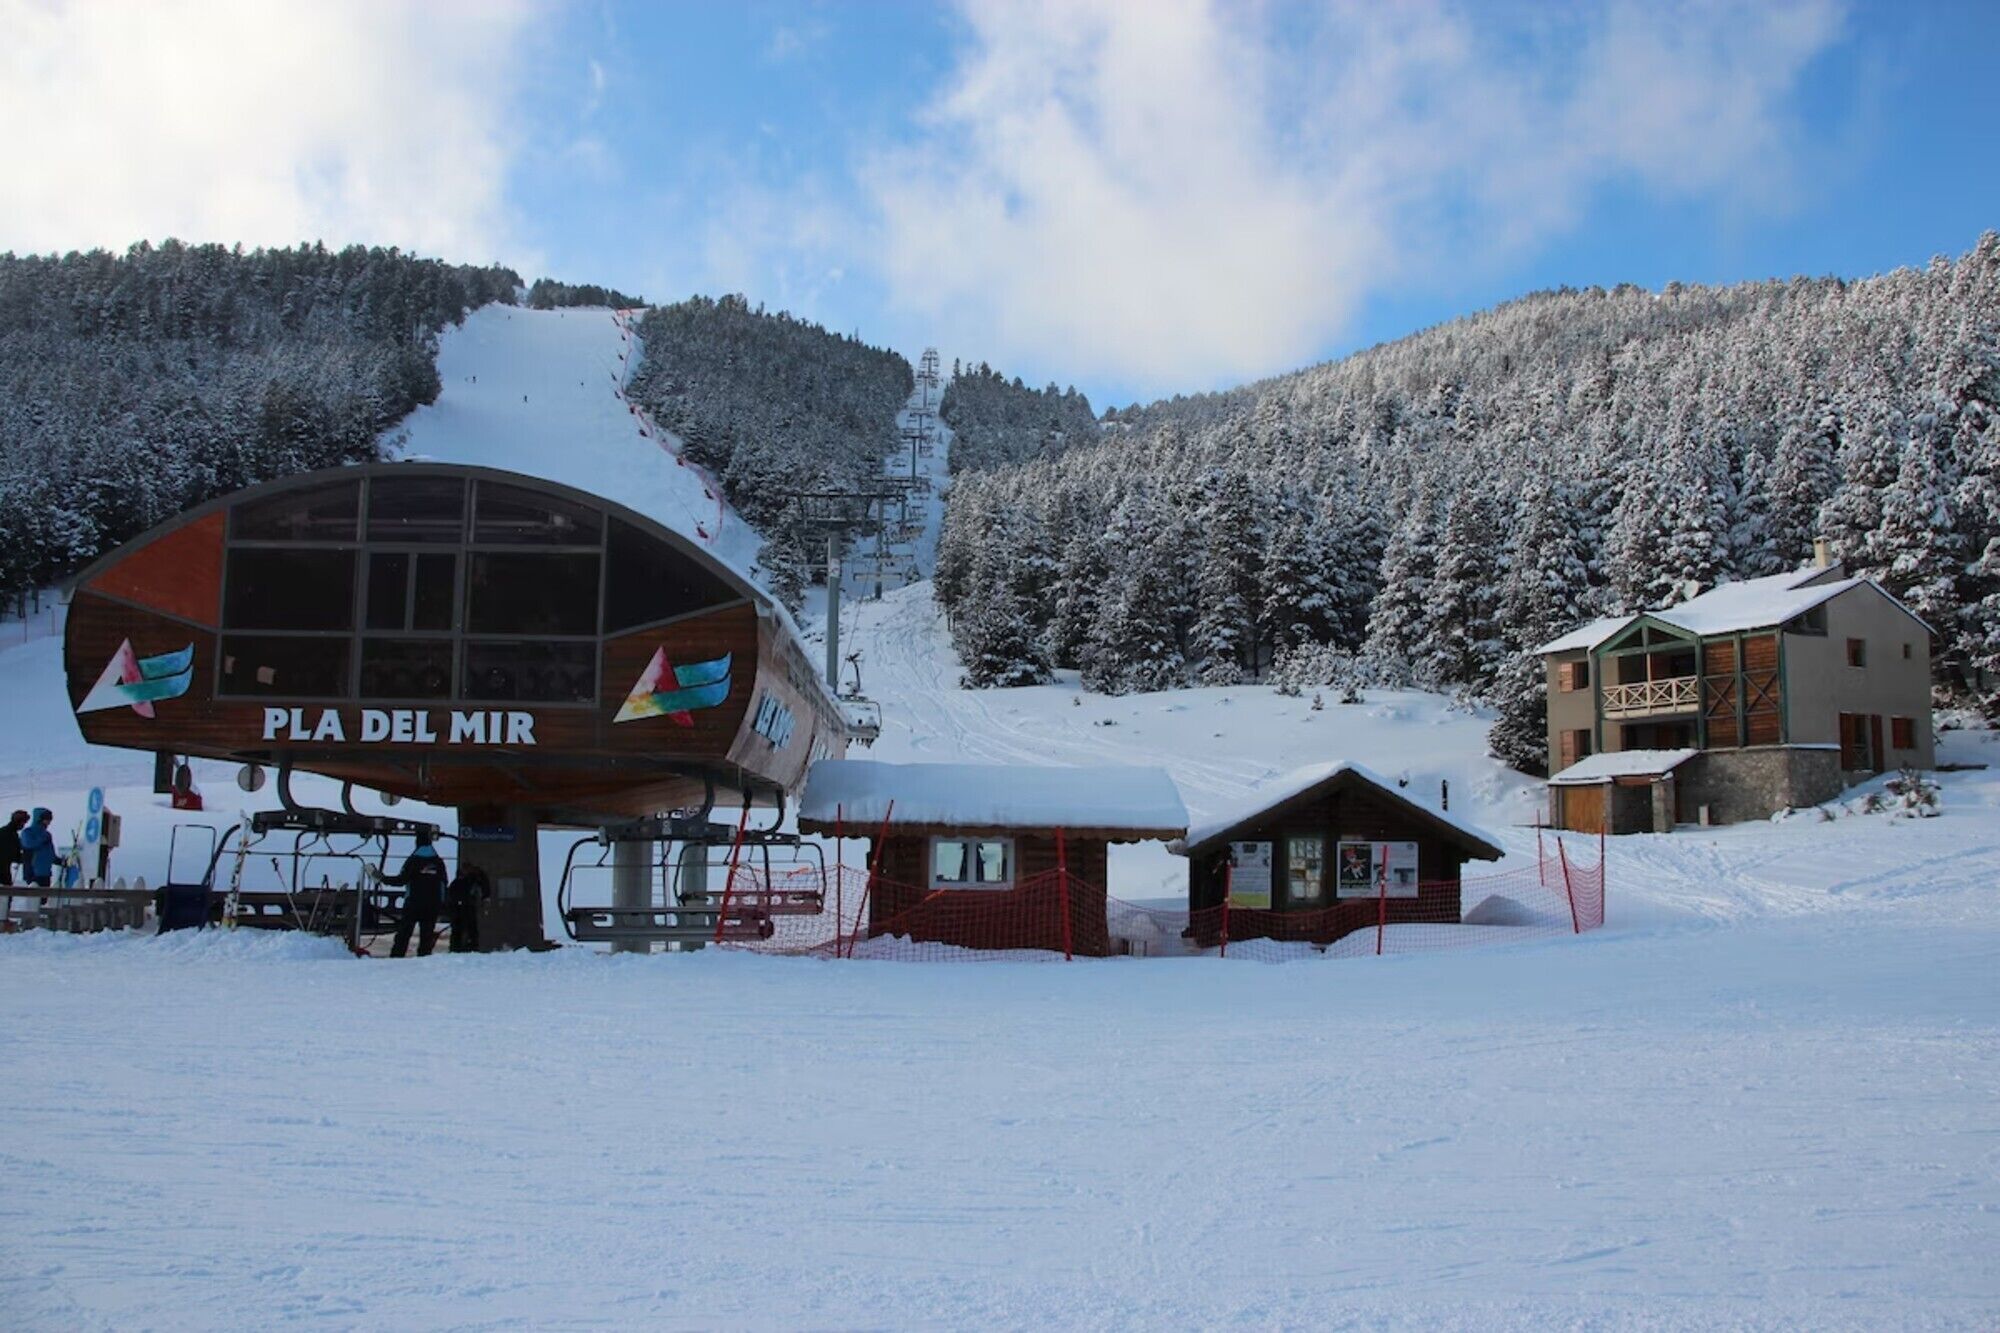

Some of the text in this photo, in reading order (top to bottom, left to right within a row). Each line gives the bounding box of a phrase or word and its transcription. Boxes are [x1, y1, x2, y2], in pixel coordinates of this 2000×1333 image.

[262, 707, 538, 745] PLA DEL MIR
